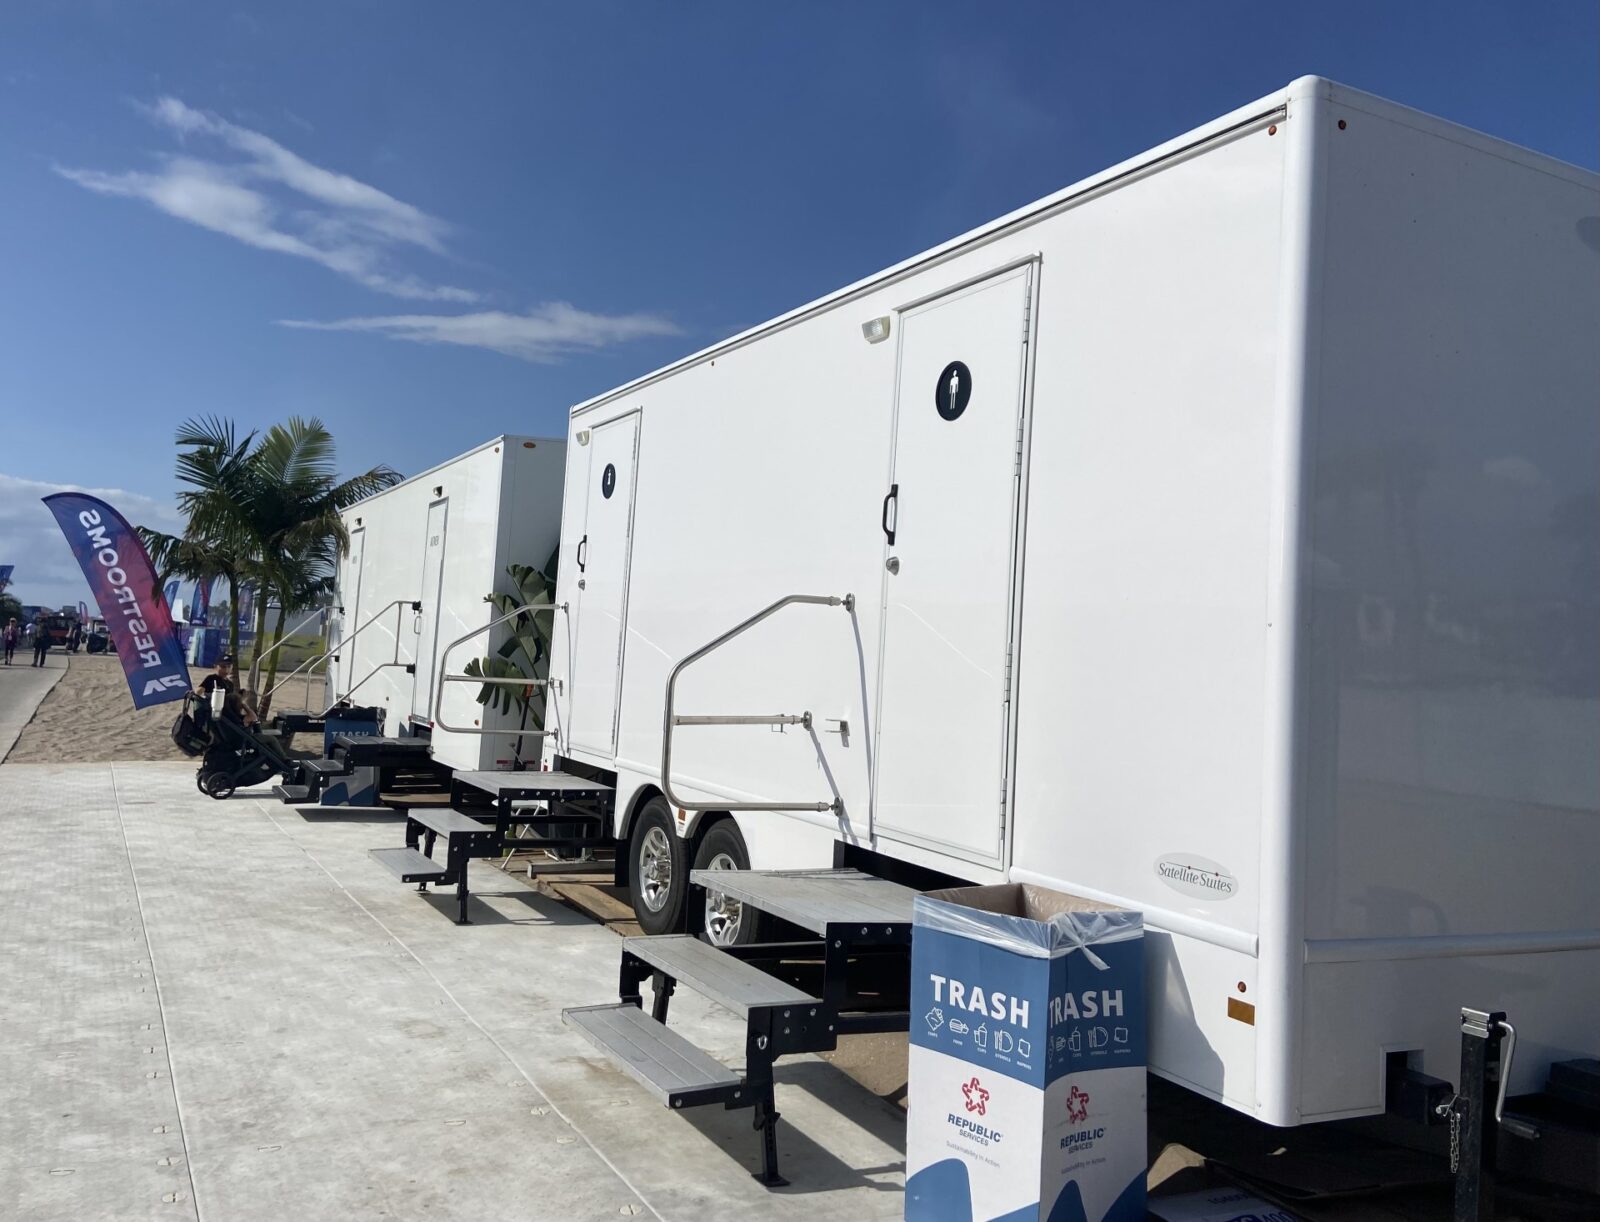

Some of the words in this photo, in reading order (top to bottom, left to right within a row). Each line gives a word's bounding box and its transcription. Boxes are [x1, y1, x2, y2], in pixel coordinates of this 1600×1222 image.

[1159, 862, 1199, 884] Satellite
[1200, 873, 1232, 893] Suites
[930, 974, 1030, 1029] TRASH
[1049, 989, 1124, 1029] TRASH
[959, 1129, 989, 1147] SERVICES
[1068, 1141, 1094, 1155] SERVICES
